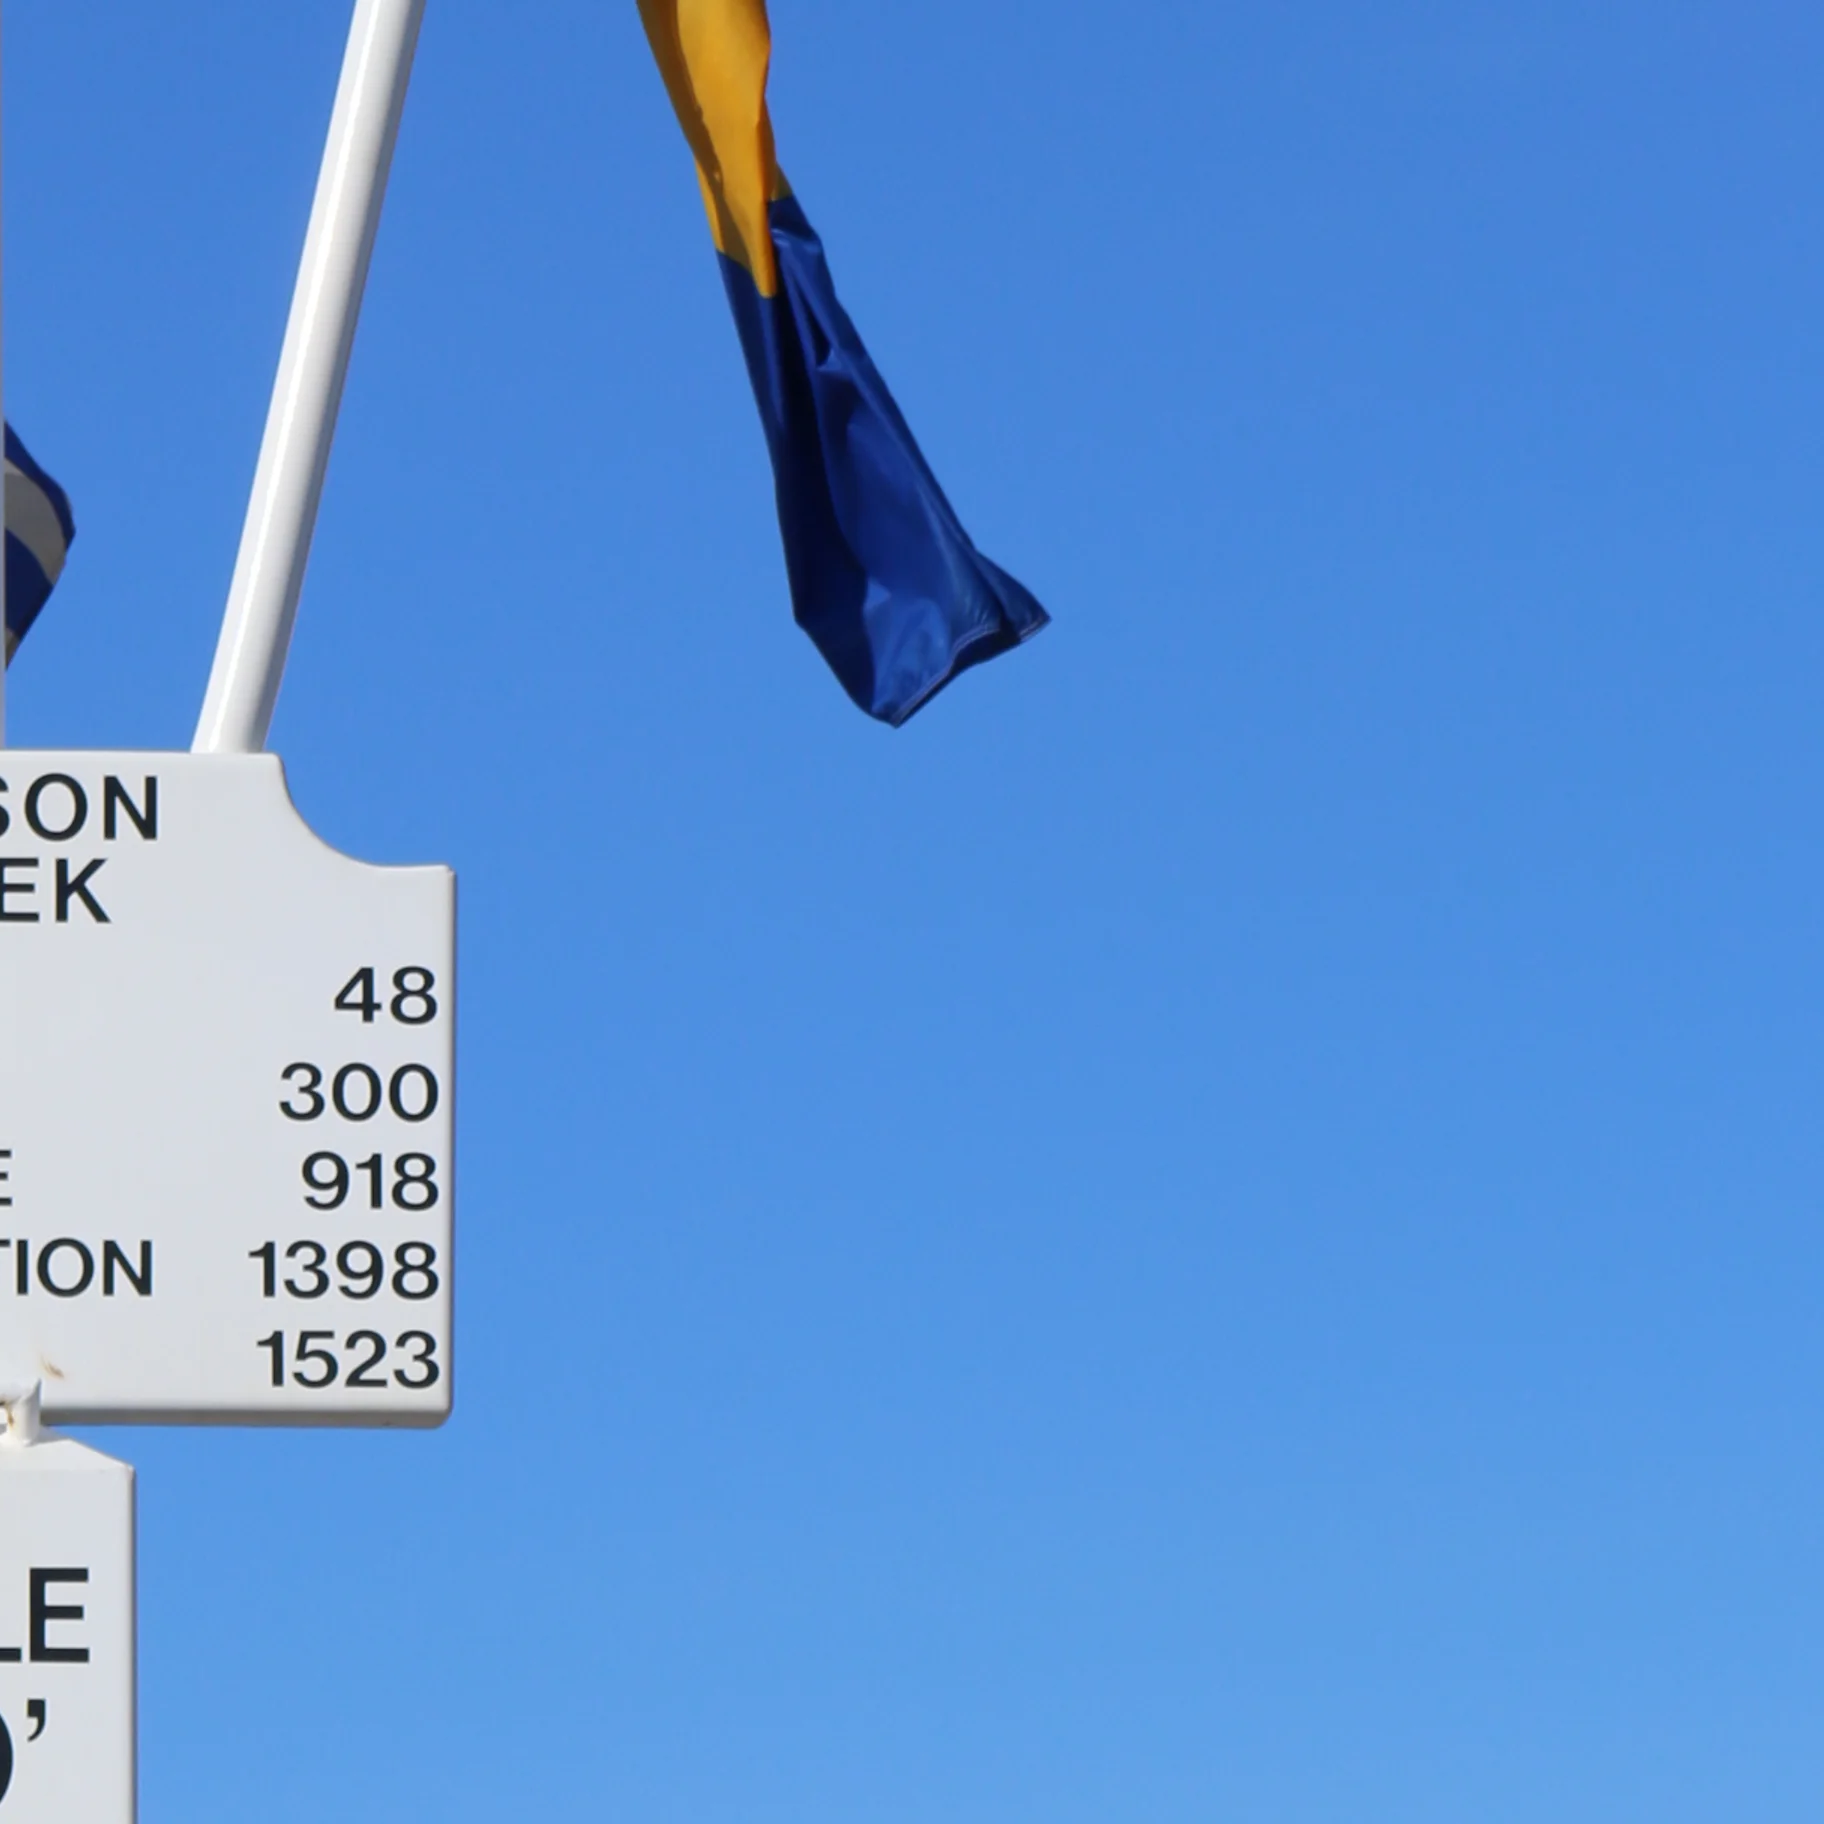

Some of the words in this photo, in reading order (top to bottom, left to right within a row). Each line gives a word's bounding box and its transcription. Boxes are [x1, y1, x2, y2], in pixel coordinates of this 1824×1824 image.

[334, 966, 437, 1025] 48
[279, 1062, 439, 1122] 300
[302, 1151, 439, 1211] 918
[249, 1240, 439, 1300] 1398
[257, 1330, 440, 1389] 1523
